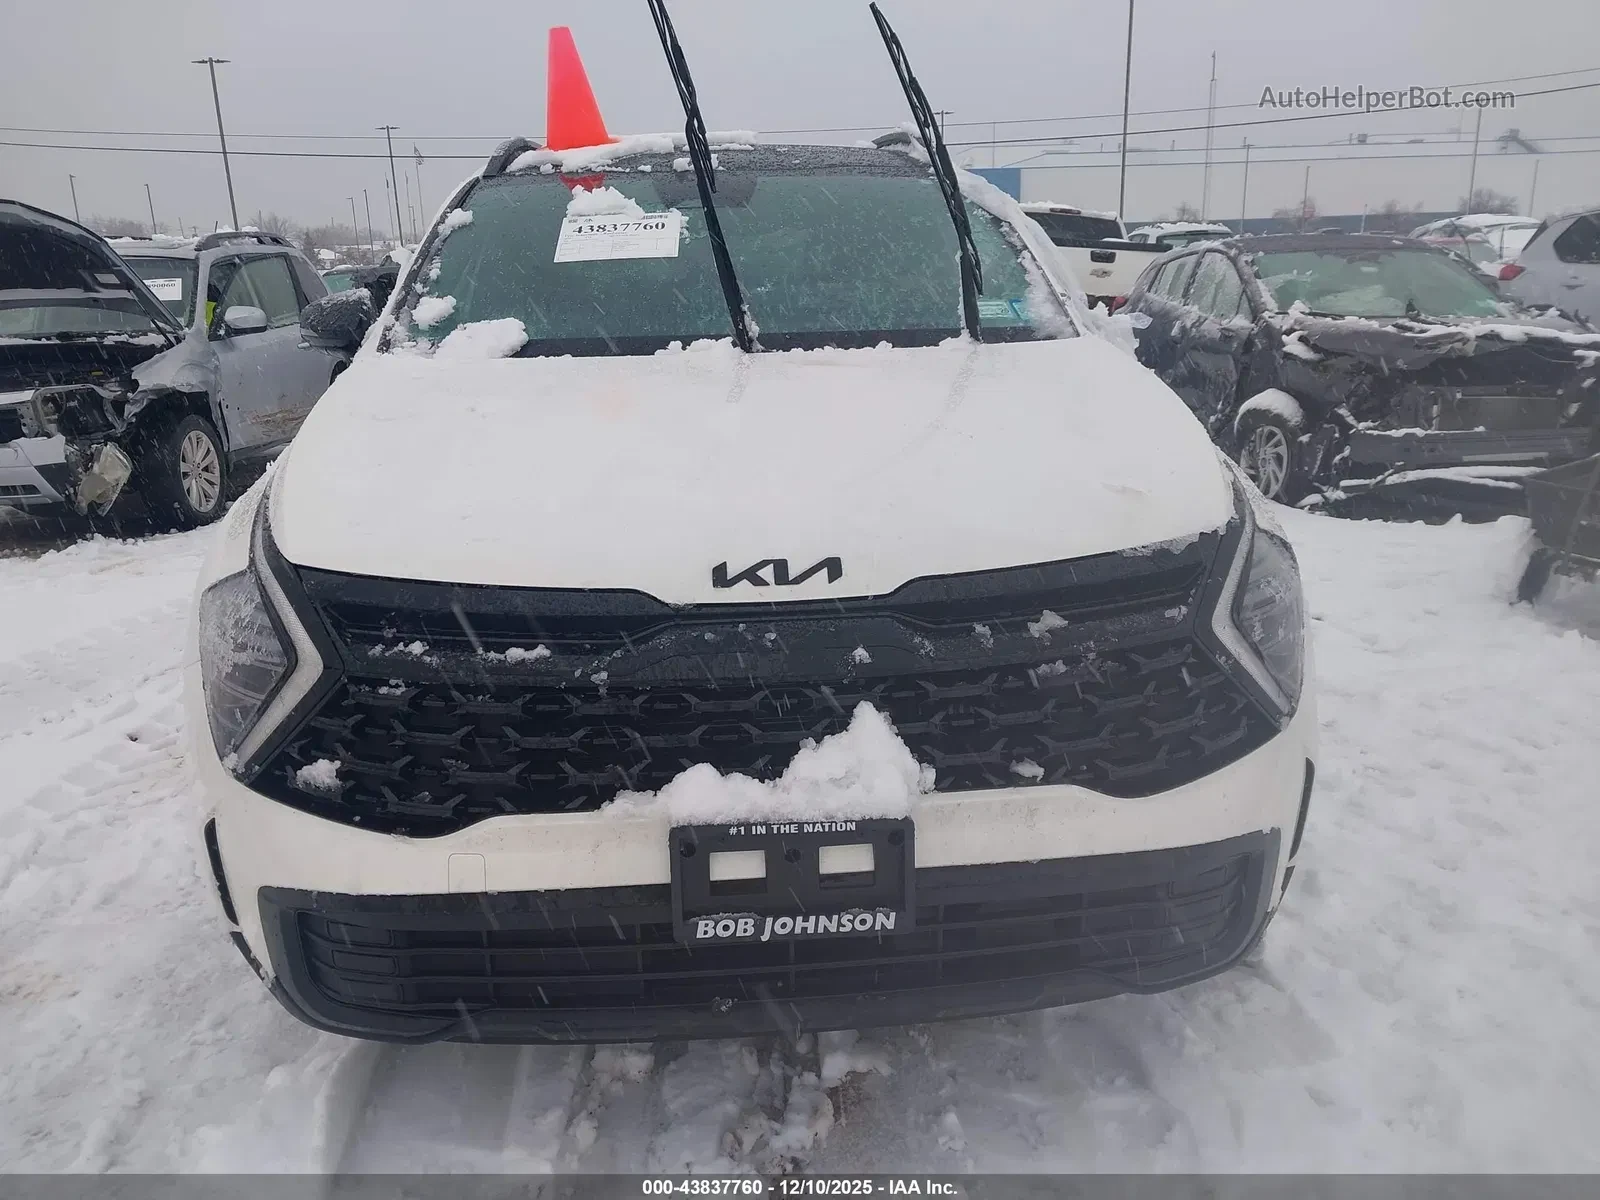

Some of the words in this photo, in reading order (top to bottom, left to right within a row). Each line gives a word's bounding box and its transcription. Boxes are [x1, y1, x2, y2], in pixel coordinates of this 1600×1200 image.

[573, 221, 666, 234] 43837760
[729, 826, 745, 835] #1
[752, 825, 766, 835] IN
[770, 823, 799, 835] THE
[803, 821, 857, 834] NATION
[695, 917, 756, 940] BOB
[760, 911, 897, 942] JOHNSON
